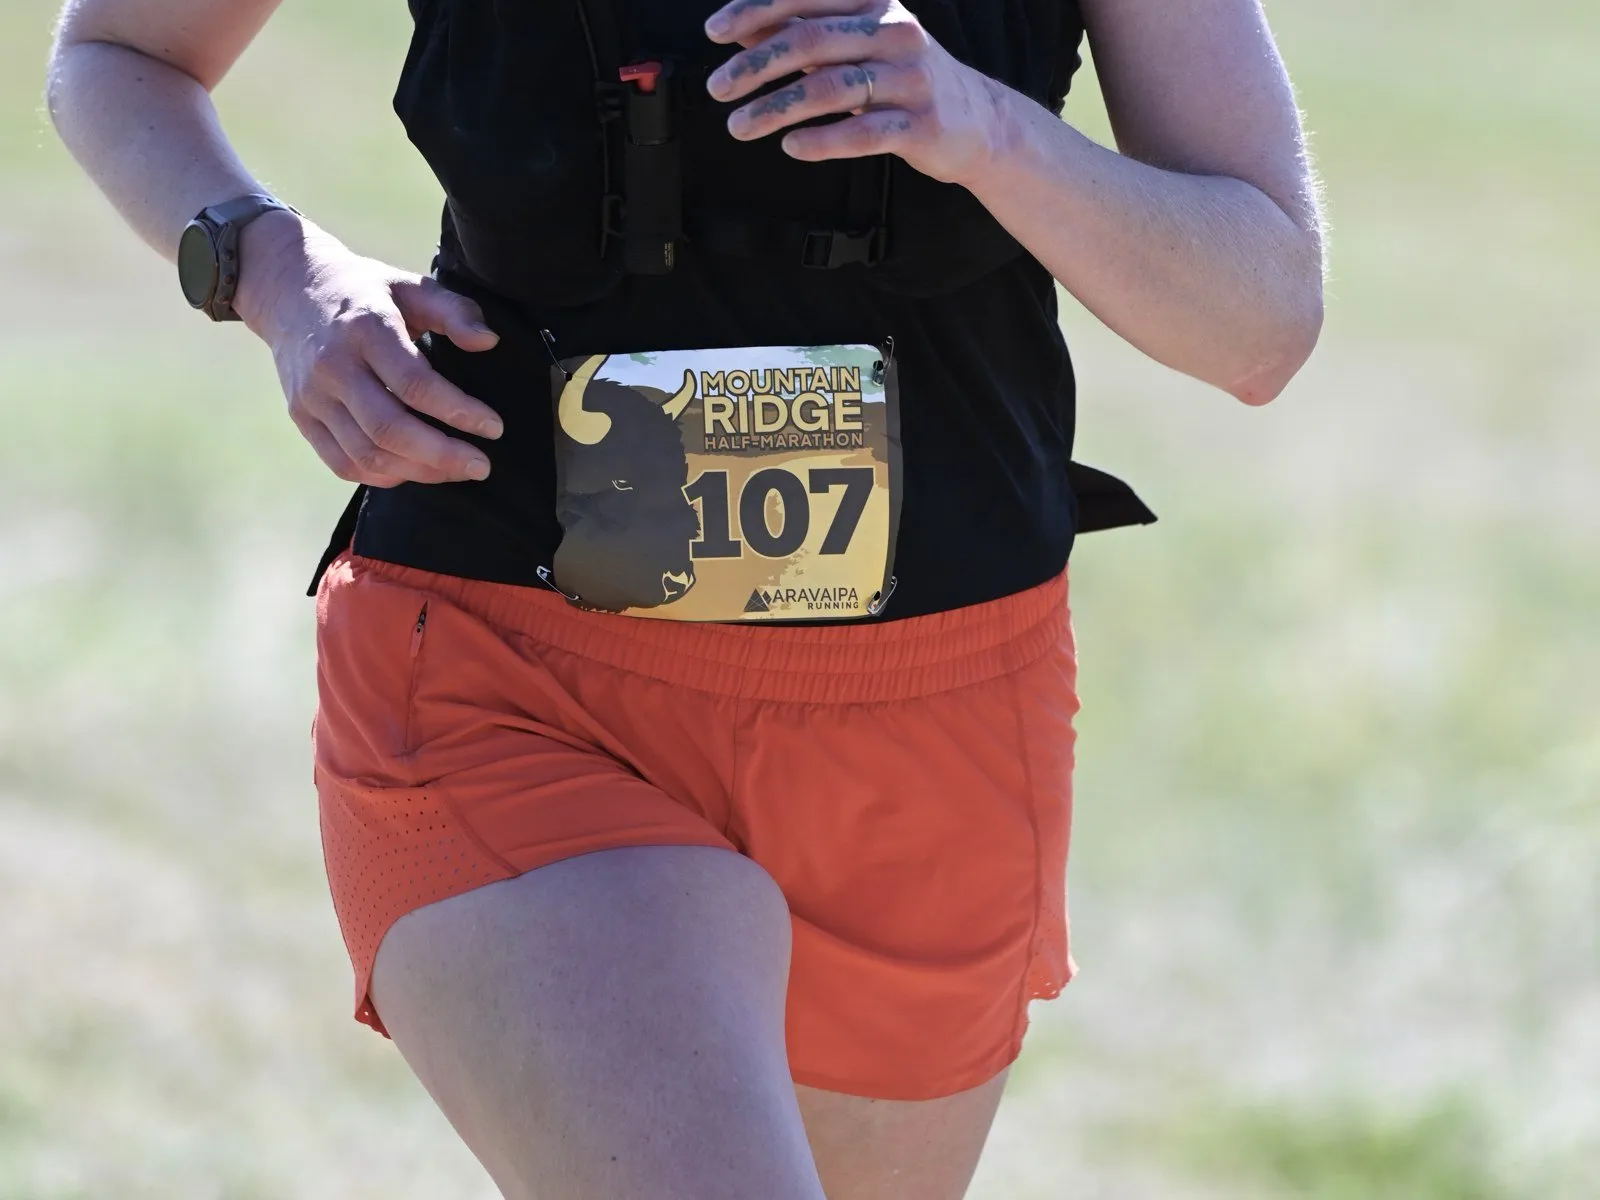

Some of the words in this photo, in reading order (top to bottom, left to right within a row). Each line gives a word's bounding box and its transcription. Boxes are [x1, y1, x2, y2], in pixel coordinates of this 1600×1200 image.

[701, 367, 860, 396] MOUNTAIN
[703, 391, 864, 434] RIDGE
[704, 433, 863, 449] HALF-MARATHON
[682, 467, 875, 560] 107
[772, 587, 859, 603] ARAVAIPA
[807, 601, 859, 610] RUNNING
